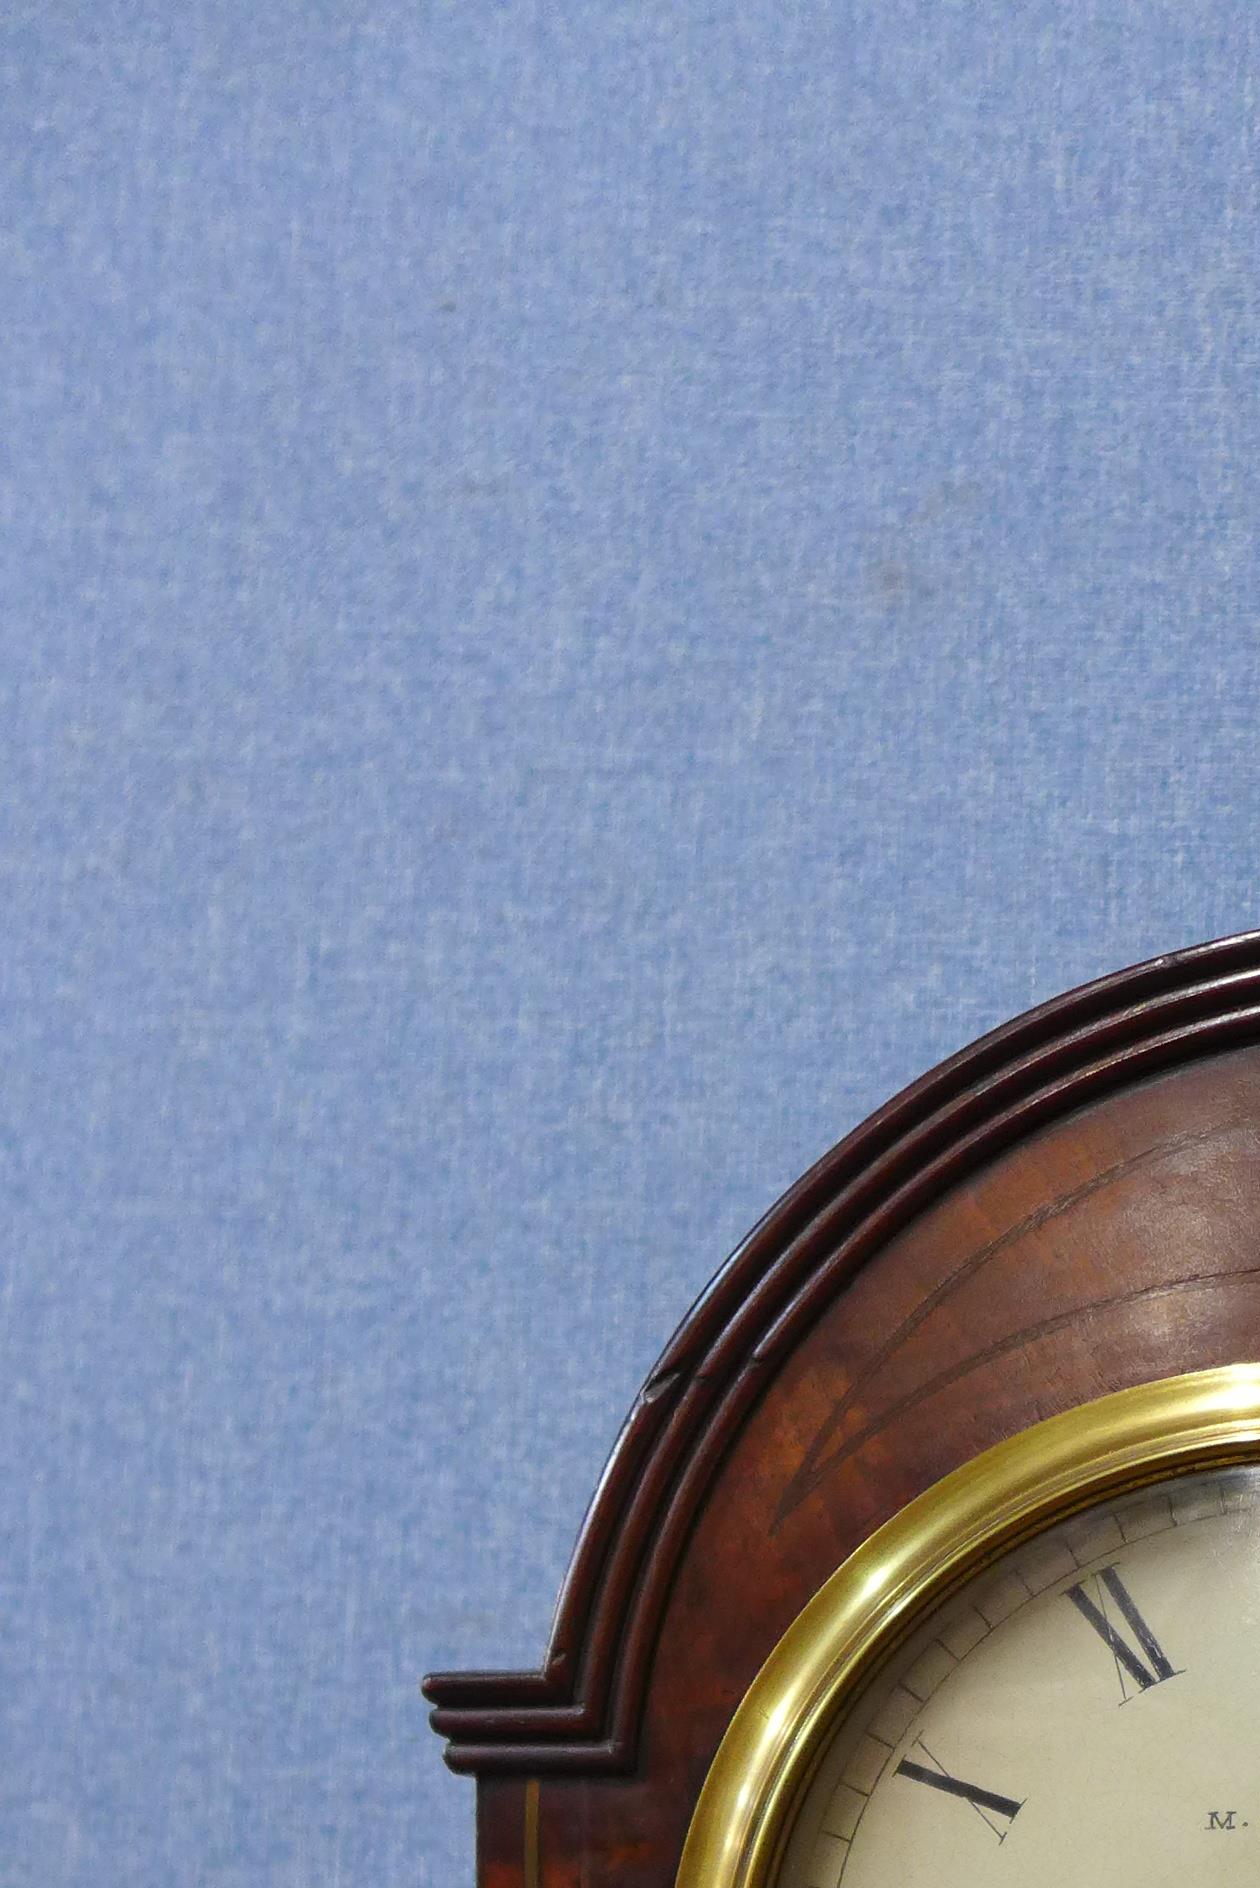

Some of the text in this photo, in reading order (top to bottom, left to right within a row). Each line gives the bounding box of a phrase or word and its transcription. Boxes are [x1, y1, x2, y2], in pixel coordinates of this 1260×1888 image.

[1059, 1561, 1187, 1706] XI
[892, 1729, 1028, 1846] X
[1204, 1809, 1249, 1832] M.
